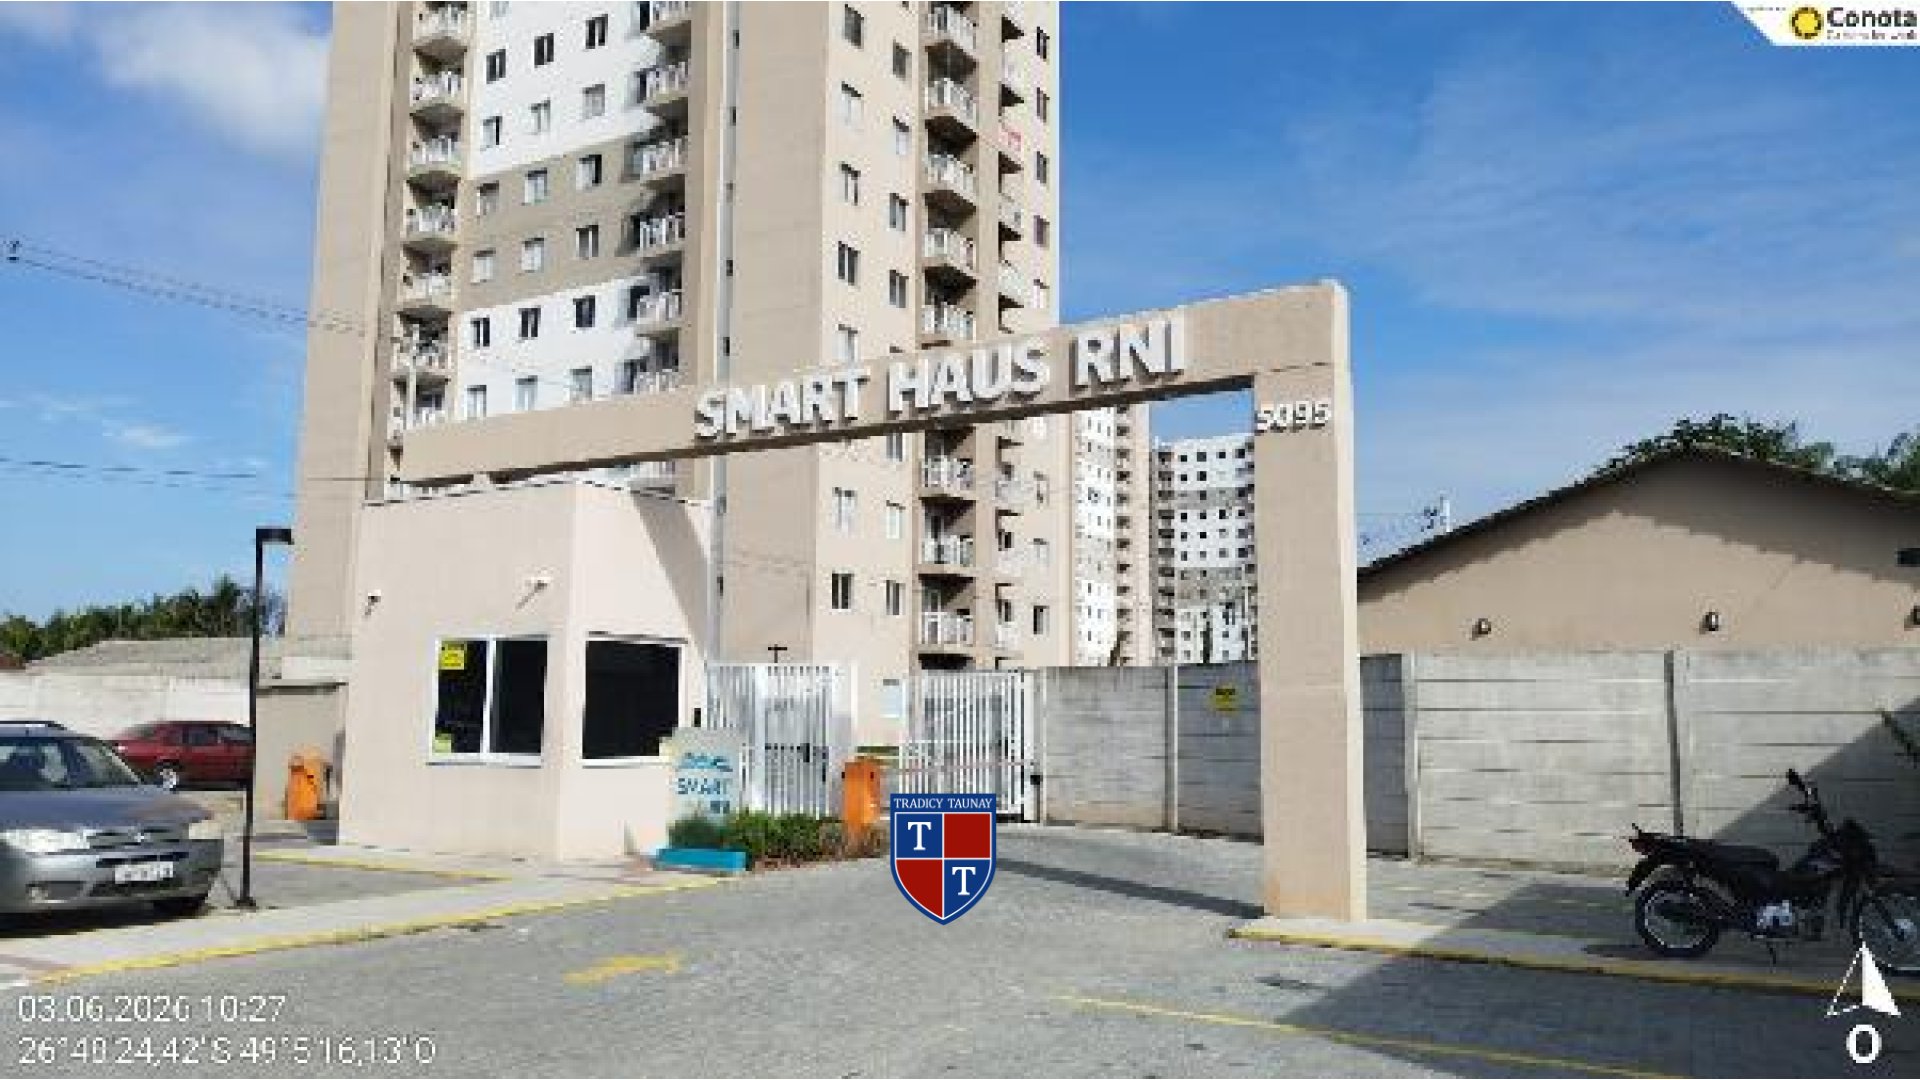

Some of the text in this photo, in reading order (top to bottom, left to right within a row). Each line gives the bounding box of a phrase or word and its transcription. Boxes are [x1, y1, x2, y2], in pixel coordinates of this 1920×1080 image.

[695, 318, 1185, 438] SMART HAUS RNI
